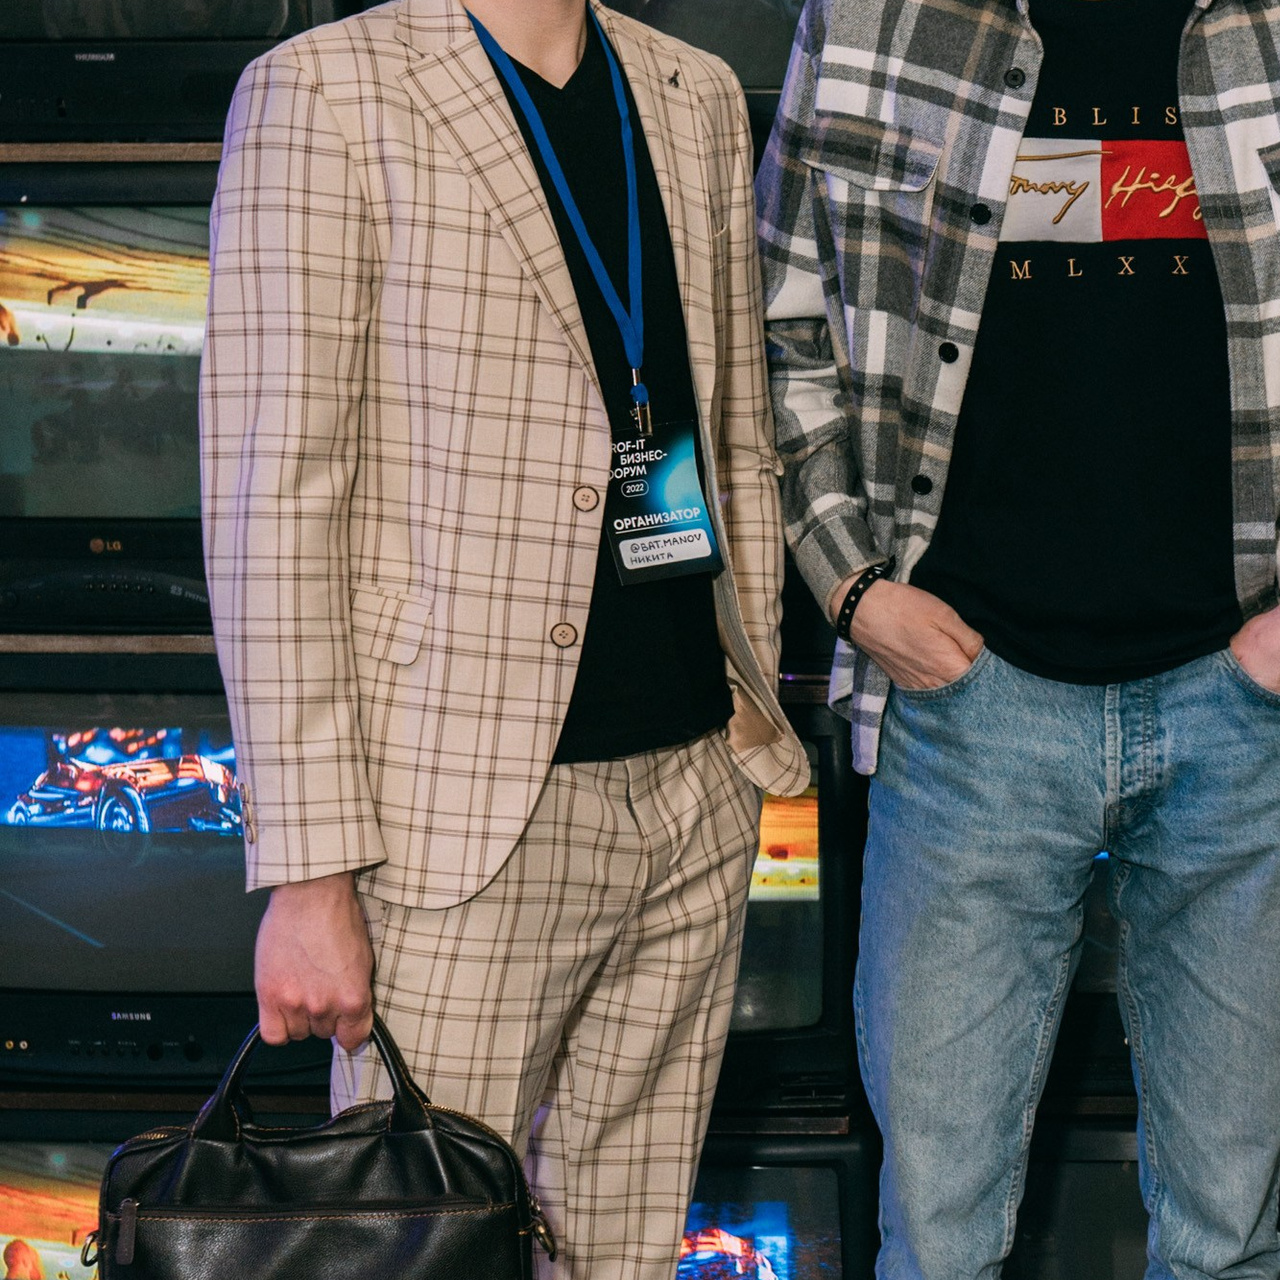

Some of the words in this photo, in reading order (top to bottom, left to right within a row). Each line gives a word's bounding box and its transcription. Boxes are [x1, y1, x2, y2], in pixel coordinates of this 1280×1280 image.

[1009, 255, 1190, 280] MLXX
[611, 438, 646, 454] ROF-IT
[625, 483, 645, 494] 2022
[613, 507, 701, 531] ОРГАНИЗАТОР
[106, 541, 122, 552] LG
[111, 1012, 152, 1021] SAMSUNG
